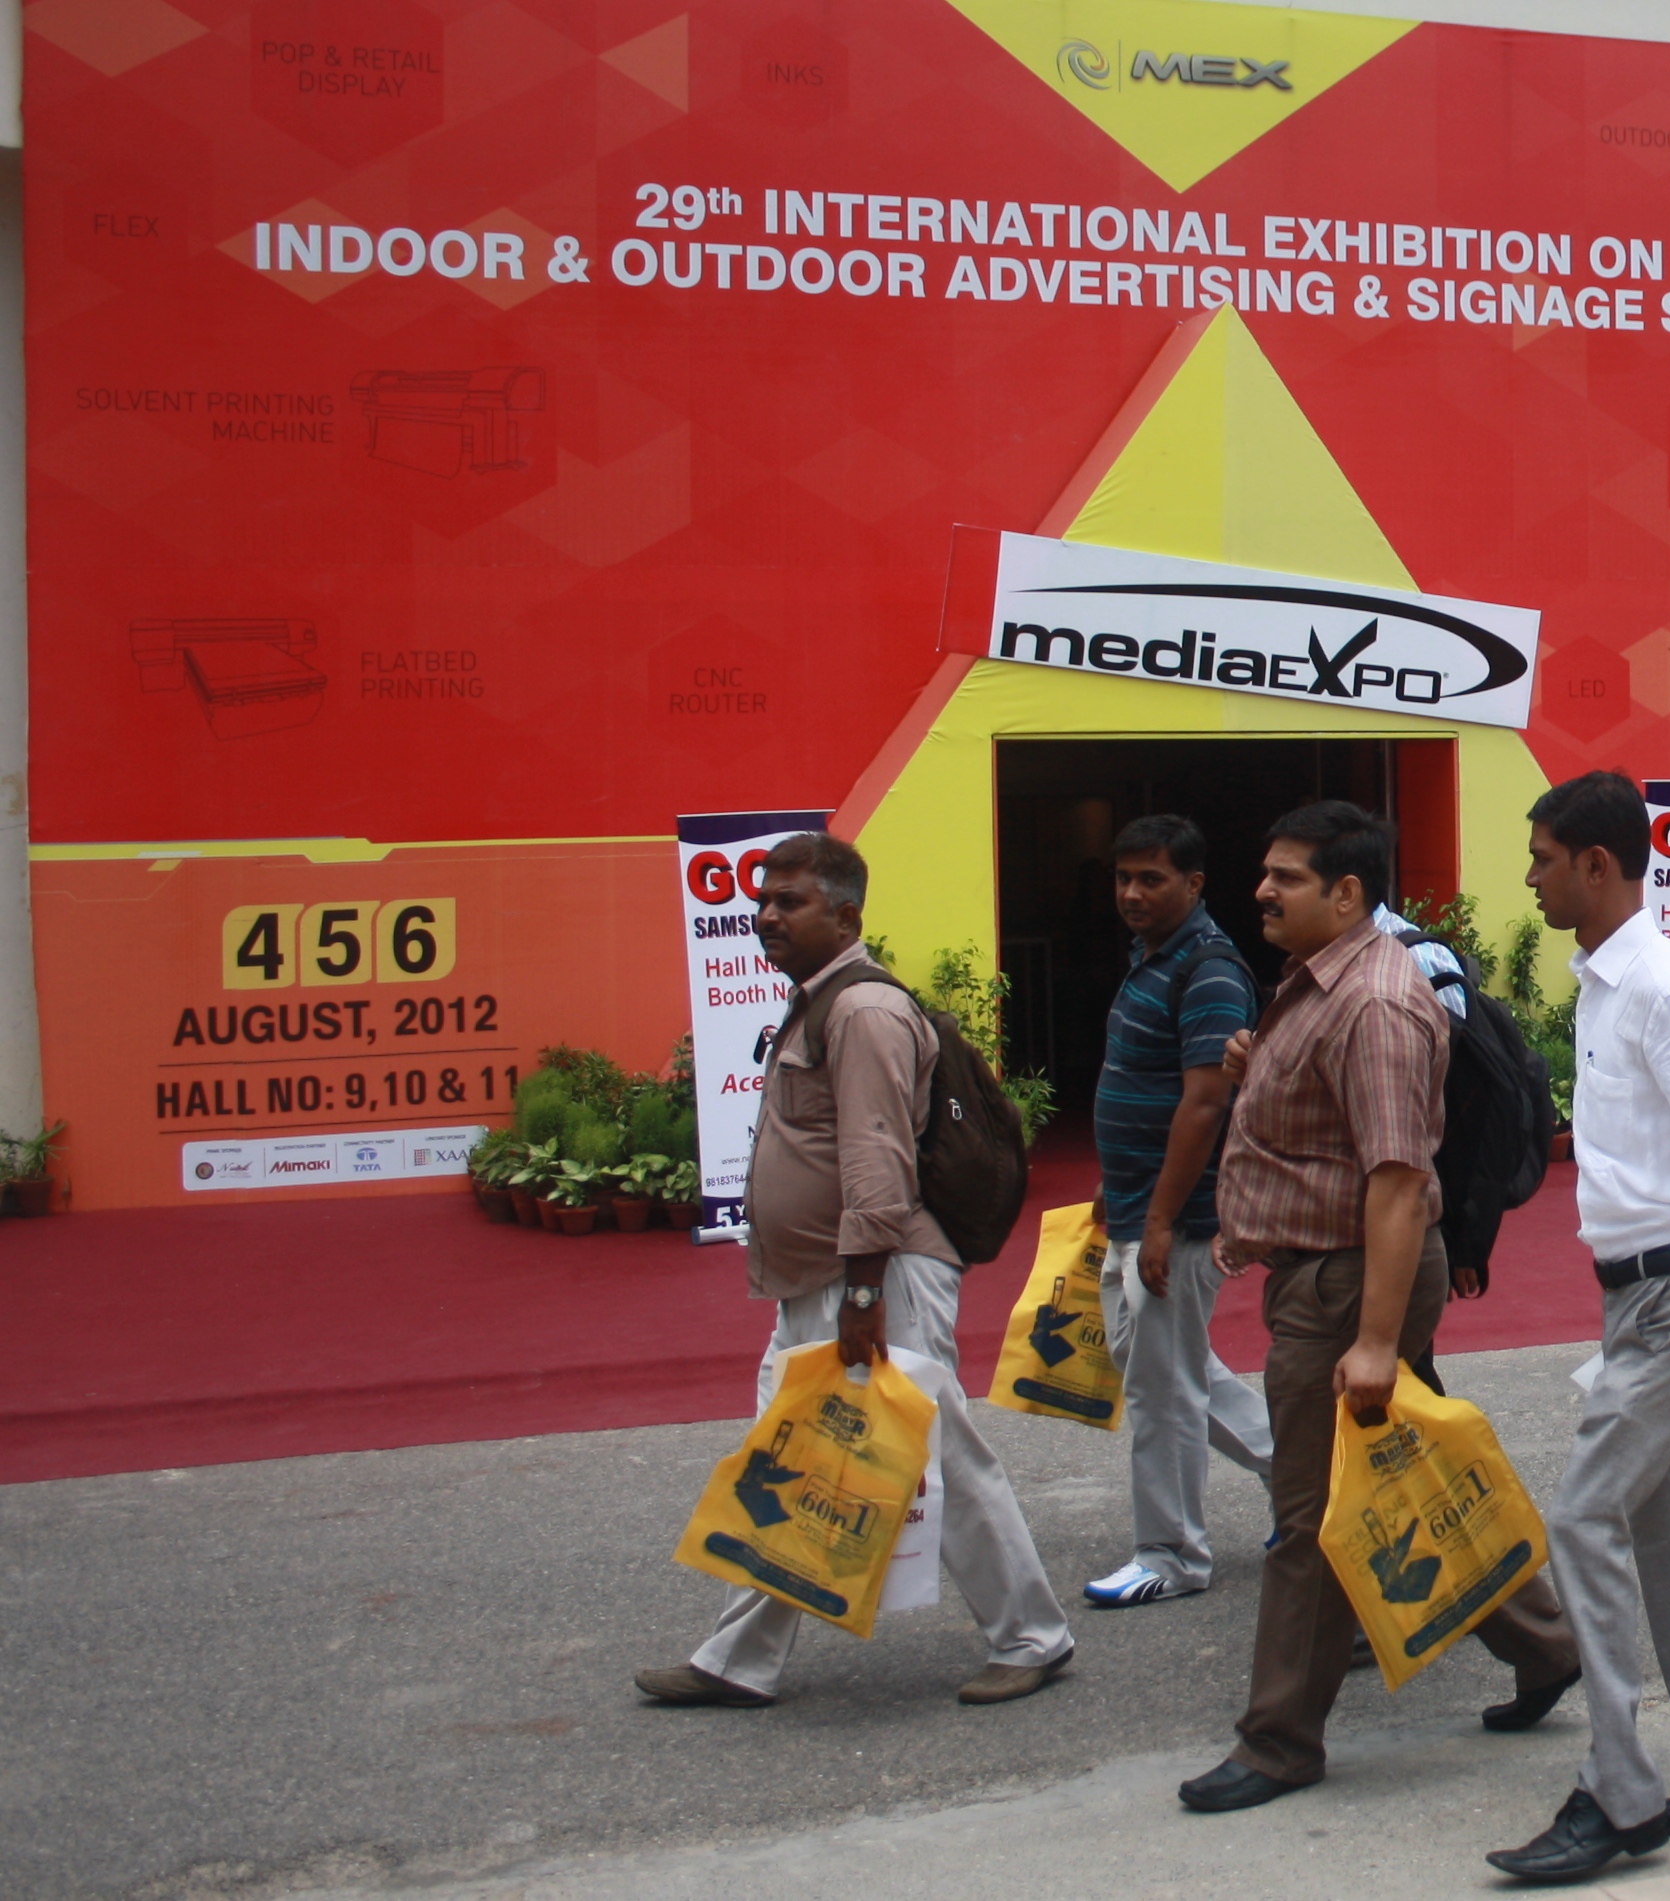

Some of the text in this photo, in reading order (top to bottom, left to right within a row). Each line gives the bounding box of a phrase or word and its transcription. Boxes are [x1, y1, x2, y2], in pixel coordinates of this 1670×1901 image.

[261, 41, 441, 75] POP & RETAIL
[1130, 48, 1294, 91] MEX
[297, 70, 407, 99] DISPLAY
[765, 63, 824, 87] INKS
[92, 213, 160, 239] FLEX
[635, 182, 1663, 281] 29th INTERNATIONAL EXHIBITION ON
[254, 221, 524, 280] INDOOR
[546, 237, 590, 284] &
[611, 238, 926, 298] OUTDOOR
[945, 255, 1334, 315] ADVERTISING
[1353, 275, 1389, 319] &
[1407, 278, 1645, 332] SIGNAGE
[75, 387, 334, 417] SOLVENT PRINTING
[212, 420, 335, 445] MACHINE
[361, 651, 477, 674] FLATBED
[361, 677, 485, 700] PRINTING
[693, 667, 742, 688] CNC
[1568, 680, 1606, 699] LED
[669, 692, 767, 715] ROUTER
[236, 905, 437, 981] 4 5 6
[705, 956, 747, 978] Hall
[708, 985, 766, 1008] Booth
[173, 994, 498, 1047] AUGUST, 2012
[156, 1080, 256, 1119] HALL
[268, 1076, 335, 1113] NO:
[438, 1068, 466, 1103] &
[481, 1065, 519, 1101] 11
[353, 1163, 381, 1172] TATA
[436, 1149, 471, 1163] XAA
